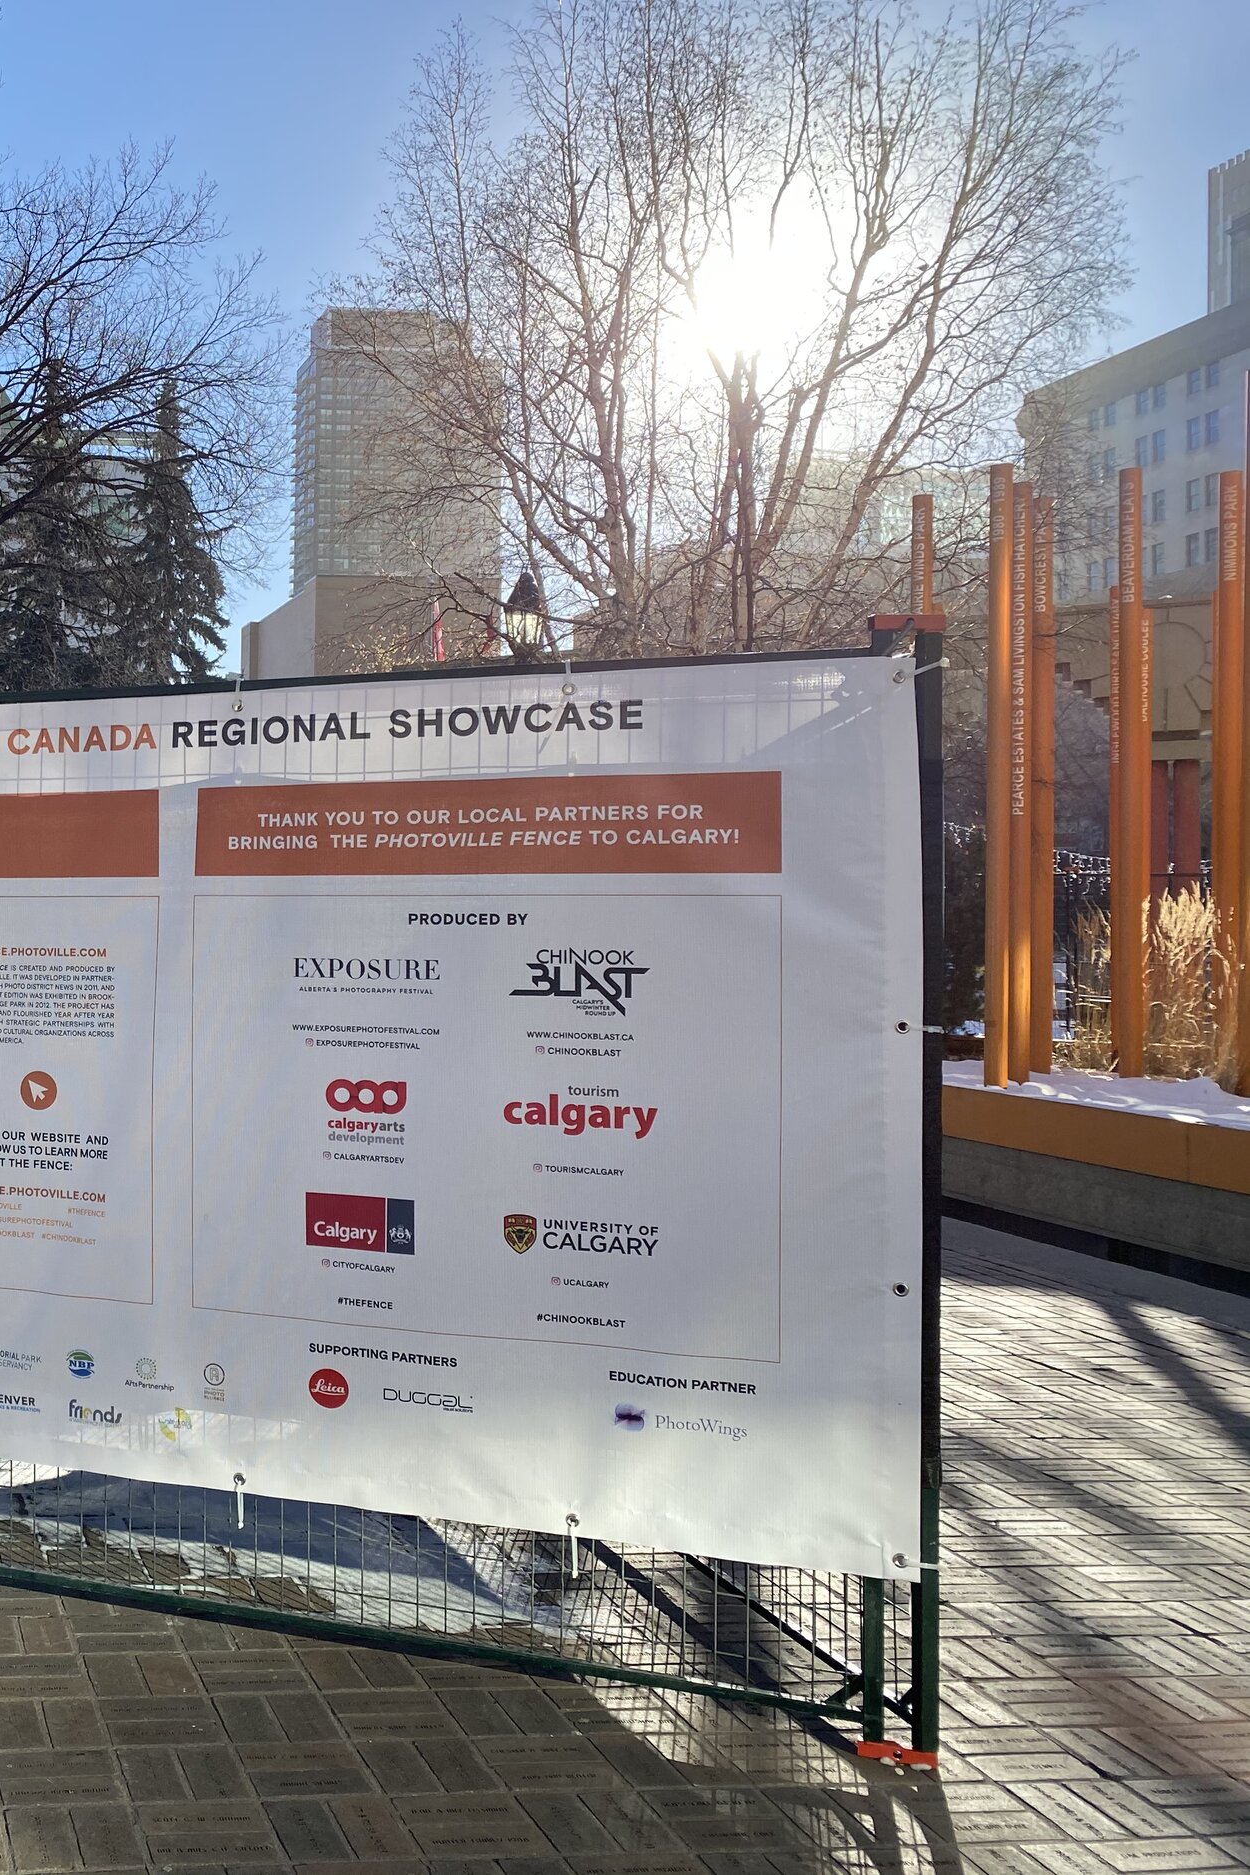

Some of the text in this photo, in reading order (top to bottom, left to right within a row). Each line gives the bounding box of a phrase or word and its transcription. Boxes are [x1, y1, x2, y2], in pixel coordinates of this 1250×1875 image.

[993, 477, 1006, 503] 1989
[915, 508, 925, 539] PARK
[993, 515, 1005, 541] 1980
[1224, 484, 1238, 581] NIMMONS PARK
[1122, 481, 1135, 603] BEAVERDAM FLATS
[914, 543, 925, 580] WINDS
[1035, 547, 1046, 612] BOWCREST
[1013, 498, 1026, 816] PEARCE ESTATES & SAM LIVINGSTON FISH HATCHERY
[7, 724, 156, 756] CANADA
[172, 712, 370, 748] REGIONAL
[389, 699, 643, 738] SHOWCASE
[258, 805, 702, 827] THANK YOU TO OUR LOCAL PARTNERS FOR
[229, 829, 738, 849] BRINGING THE PHOTOVILLE FENCE TO CALGARY!
[409, 913, 528, 925] PRODUCED BY
[536, 947, 634, 965] CHINOOK
[294, 958, 440, 980] EXPOSURE
[509, 963, 650, 1016] BLAST
[292, 1025, 439, 1035] WWW.EXPOSUREPHOTOFESTIVAL.COM
[527, 1032, 634, 1041] WWW.CHINOOKBLAST.CA
[317, 1040, 420, 1049] EXPOSUREPHOTOFESTIVAL
[548, 1047, 621, 1056] CHINOOKBLAST
[568, 1086, 619, 1097] tourism
[504, 1095, 658, 1138] calgary
[328, 1118, 405, 1133] calgaryarts
[2, 1131, 25, 1140] OUR
[31, 1132, 80, 1143] WEBSITE
[86, 1135, 108, 1145] AND
[329, 1131, 404, 1145] development
[13, 1145, 26, 1154] US
[29, 1146, 42, 1155] TO
[45, 1147, 77, 1157] LEARN
[80, 1149, 107, 1159] MORE
[334, 1153, 404, 1164] CALGARYARTSDEV
[9, 1159, 29, 1168] THE
[34, 1160, 72, 1170] FENCE:
[545, 1165, 624, 1176] TOURISMCALGARY
[68, 1208, 105, 1217] #THEFENCE
[314, 1221, 377, 1244] Calgary
[543, 1219, 658, 1238] UNIVERSITY OF
[42, 1233, 96, 1245] #CHINOOKBLAST
[543, 1232, 658, 1256] CALGARY
[333, 1261, 395, 1272] CITYOFCALGARY
[564, 1279, 609, 1288] UCALGARY
[338, 1298, 392, 1309] #THEFENCE
[537, 1314, 625, 1328] #CHINOOKBLAST
[21, 1354, 41, 1363] PARK
[309, 1343, 457, 1367] SUPPORTING PARTNERS
[69, 1360, 94, 1369] NBP
[125, 1379, 174, 1392] Arts Partnership
[312, 1379, 345, 1395] Leica
[610, 1371, 756, 1395] EDUCATION PARTNER
[656, 1415, 747, 1441] PhotoWings
